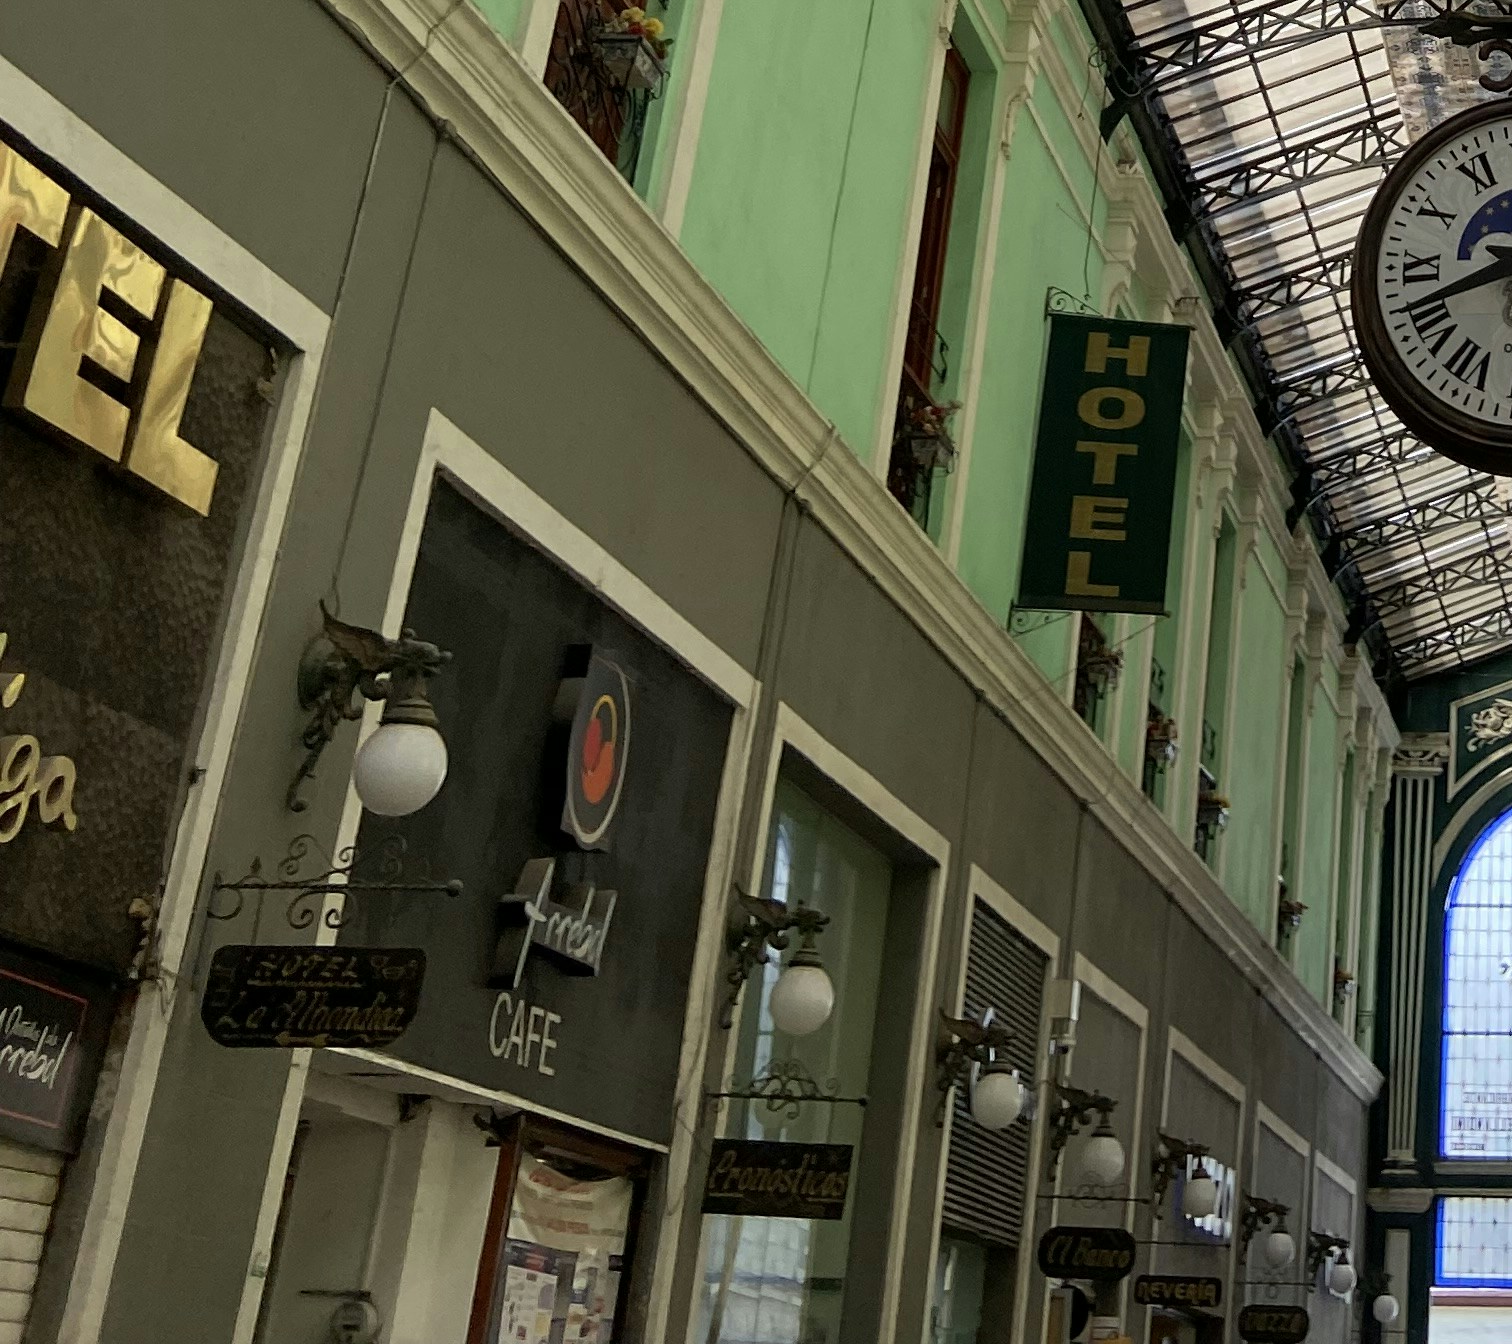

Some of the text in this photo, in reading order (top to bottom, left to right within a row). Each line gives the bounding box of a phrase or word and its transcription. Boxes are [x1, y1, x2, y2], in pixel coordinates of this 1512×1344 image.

[1455, 150, 1499, 196] XI
[1416, 194, 1458, 231] X
[1402, 249, 1441, 286] IX
[1406, 301, 1459, 359] VIII
[1443, 336, 1493, 393] VII
[1063, 331, 1152, 599] HOTEL
[488, 991, 563, 1078] CAFE
